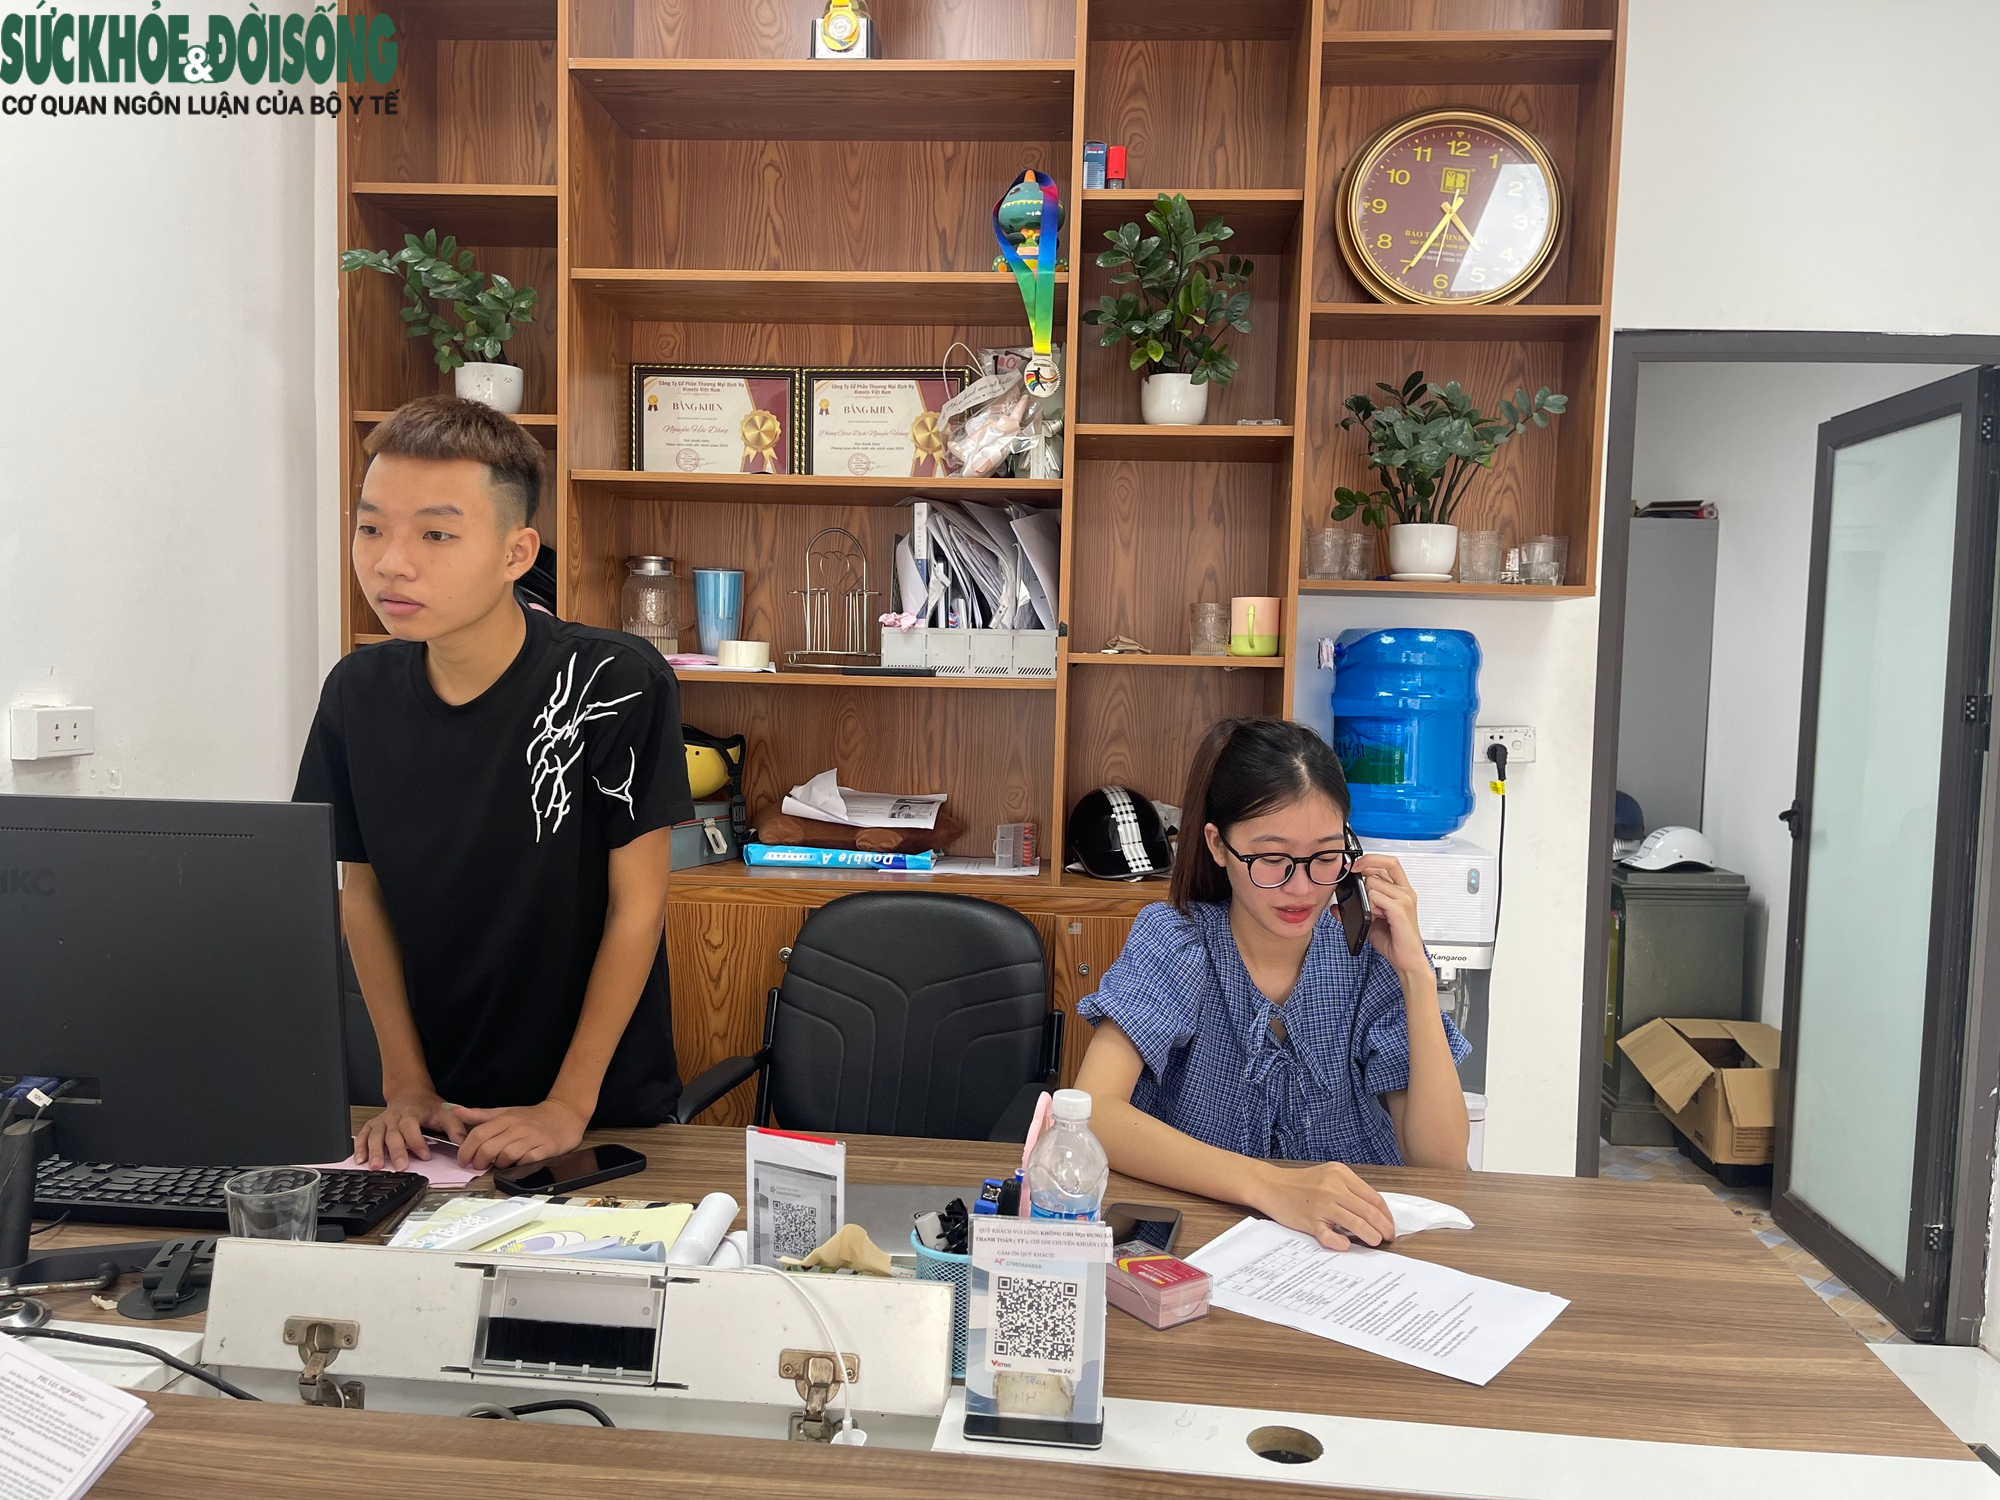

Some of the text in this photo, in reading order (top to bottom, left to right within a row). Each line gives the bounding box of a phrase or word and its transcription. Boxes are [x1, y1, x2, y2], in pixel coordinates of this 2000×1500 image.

[1413, 146, 1432, 163] 11
[1447, 140, 1471, 157] 12
[1489, 153, 1499, 169] 1
[1386, 168, 1411, 185] 10
[1508, 181, 1524, 197] 2
[1372, 198, 1387, 214] 9
[1512, 214, 1529, 230] 3
[1377, 233, 1393, 249] 8
[1499, 247, 1514, 262] 4
[1432, 274, 1449, 289] 6
[1471, 268, 1487, 283] 5
[699, 402, 723, 411] KHEN
[870, 406, 894, 414] KHEN
[822, 851, 895, 866] Double A
[1430, 953, 1467, 962] Kangaroo
